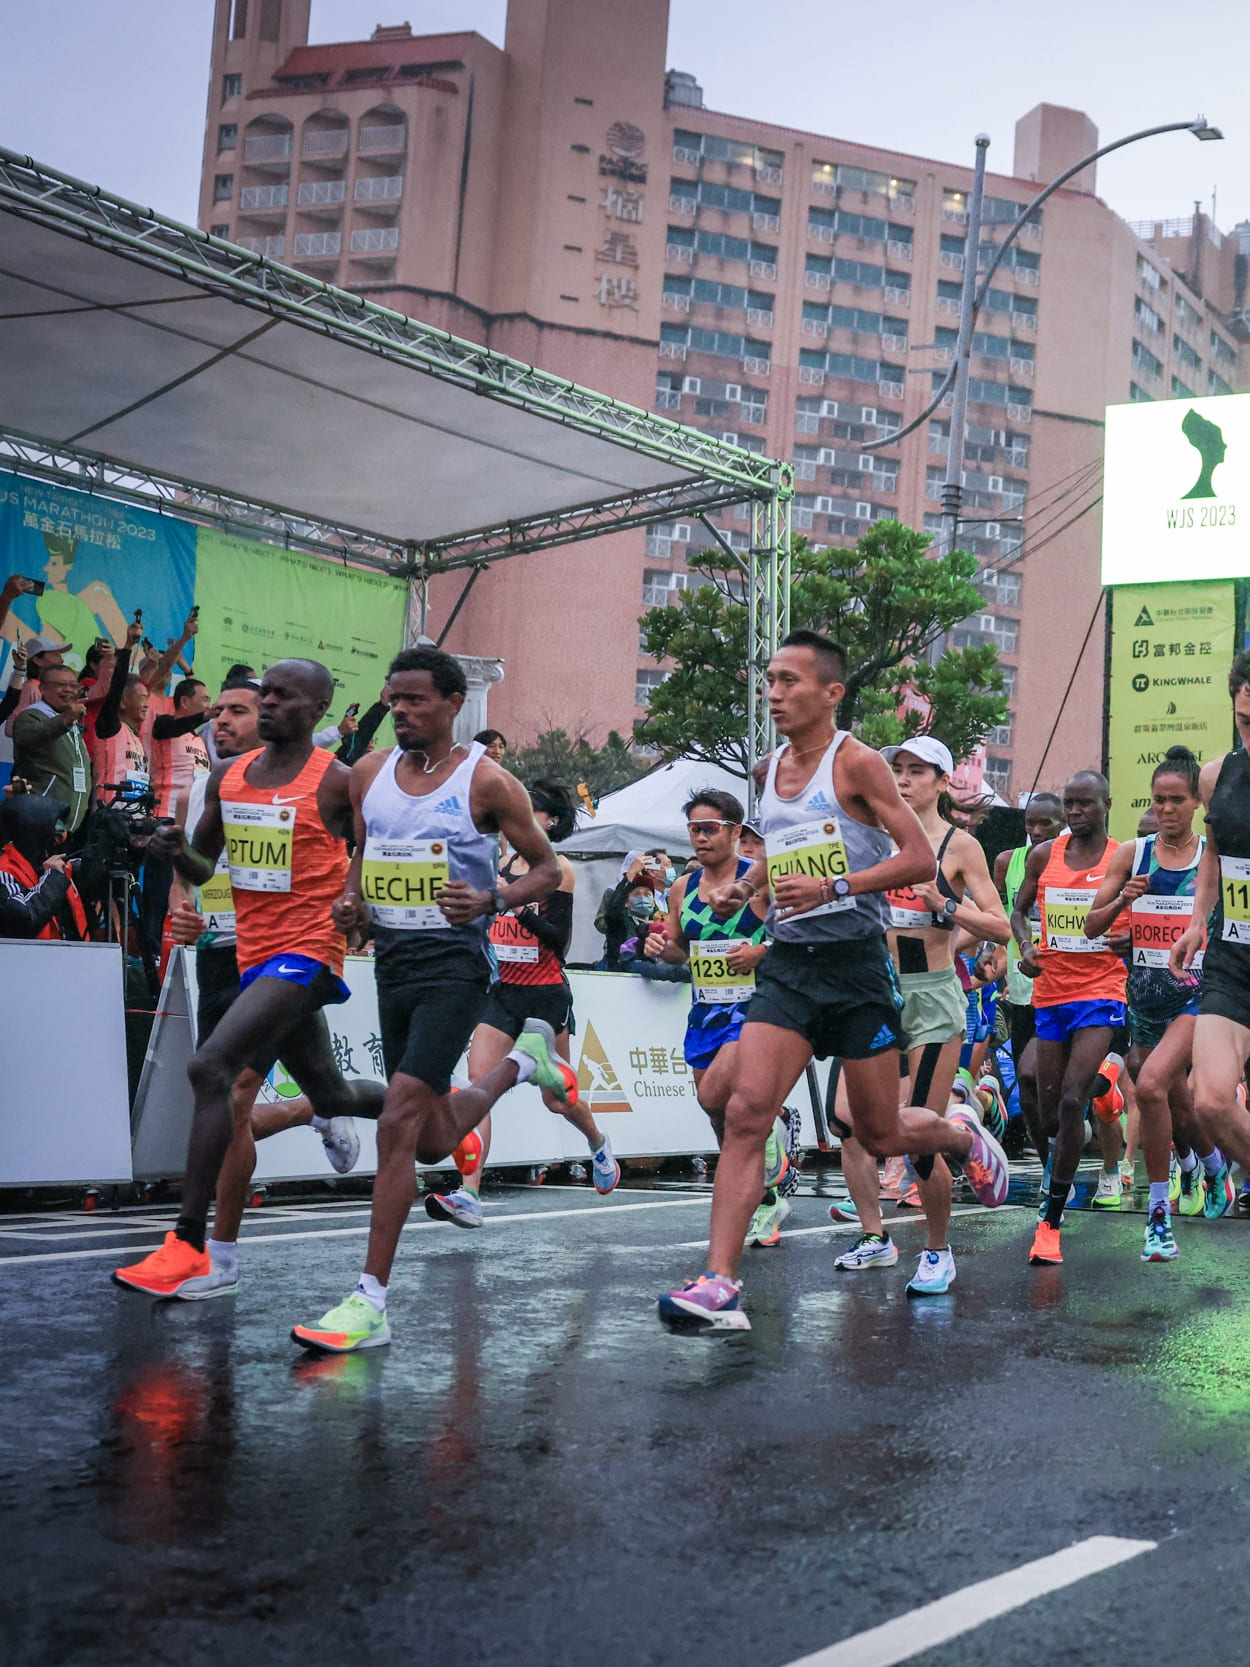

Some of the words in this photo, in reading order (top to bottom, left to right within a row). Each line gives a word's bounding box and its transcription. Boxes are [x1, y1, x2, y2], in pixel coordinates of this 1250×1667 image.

[24, 496, 114, 528] MARATHON
[117, 521, 157, 541] 2023
[1166, 509, 1194, 529] WJS
[1200, 504, 1237, 527] 2023
[23, 510, 121, 550] 萬金石馬拉松
[1153, 641, 1213, 658] 富邦金控
[1152, 676, 1213, 687] KINGWHALE
[365, 875, 443, 902] LECHE
[1135, 924, 1186, 943] BOREC
[1228, 922, 1240, 939] A
[1050, 936, 1058, 949] A
[1137, 950, 1147, 964] A
[698, 988, 706, 1001] A
[630, 1046, 692, 1075] 中華台
[634, 1080, 685, 1098] Chinese
